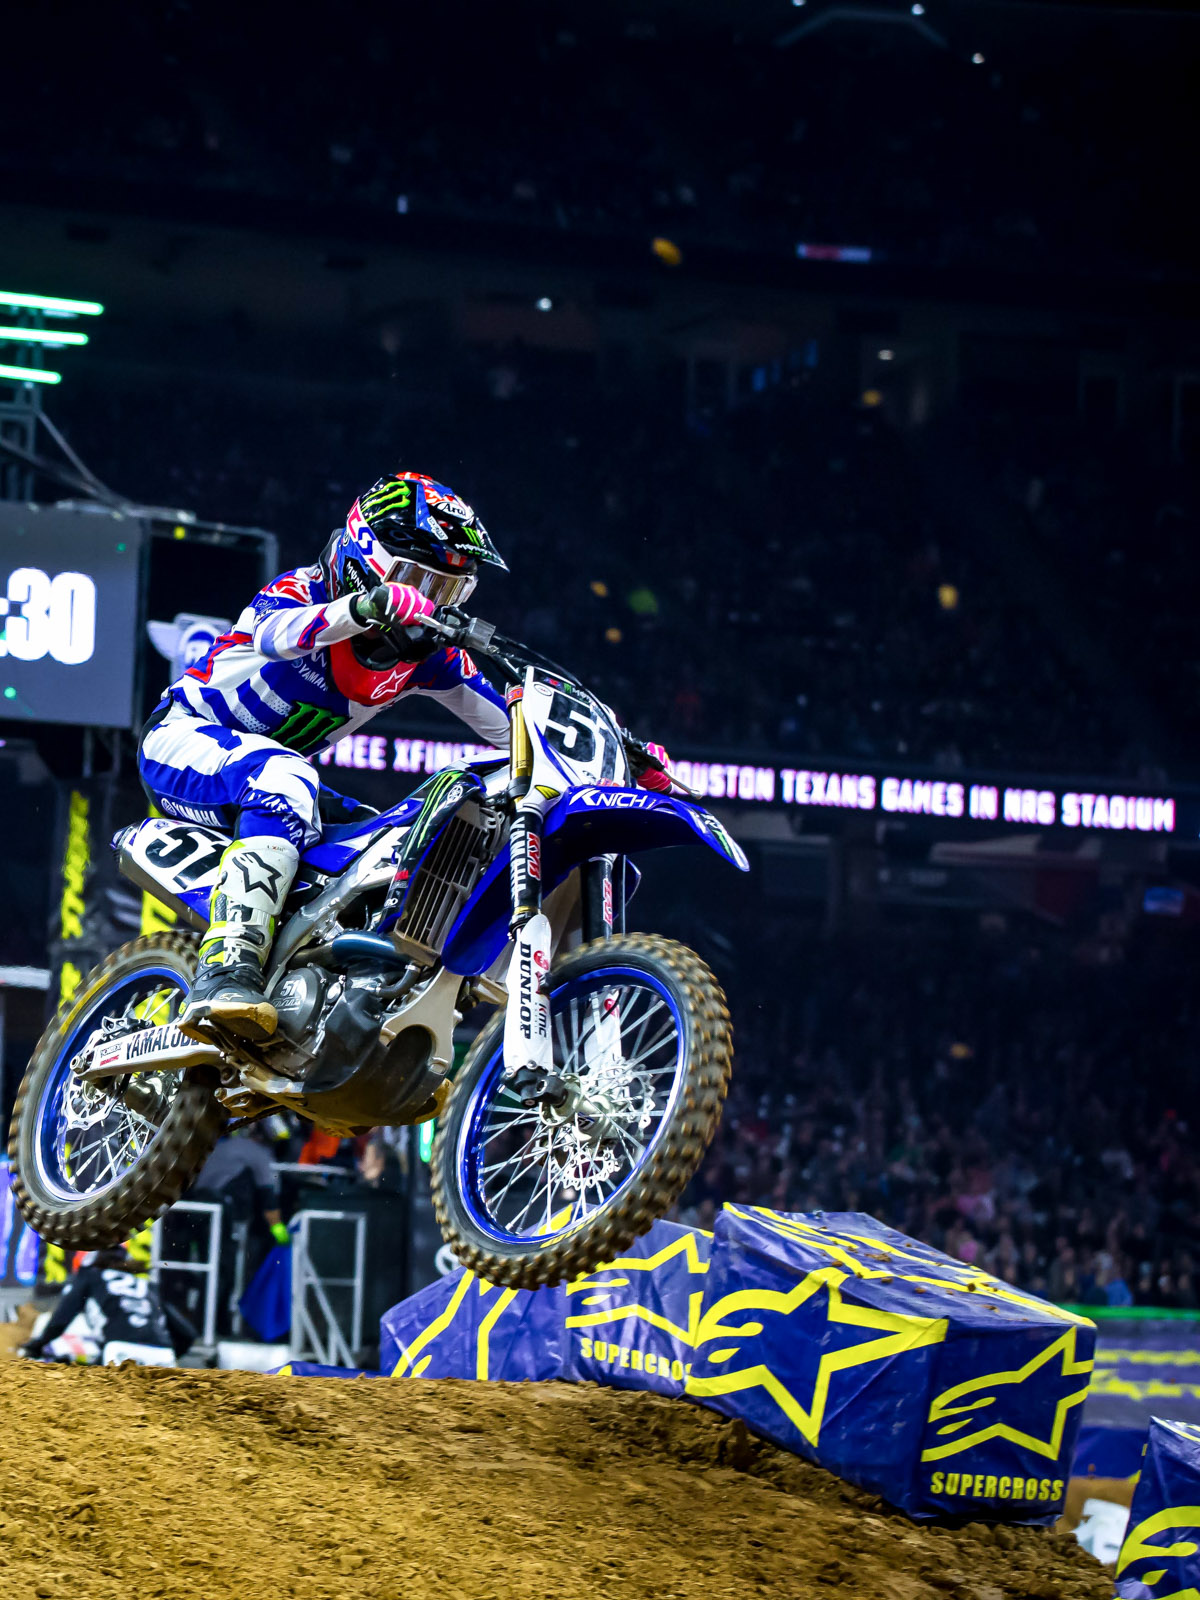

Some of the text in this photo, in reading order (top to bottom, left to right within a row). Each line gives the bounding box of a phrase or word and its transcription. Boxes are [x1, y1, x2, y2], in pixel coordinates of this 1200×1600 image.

[544, 691, 624, 785] 51
[172, 802, 222, 827] YAMAHA
[667, 760, 1176, 832] OUSTON TEXANS GAMES IN NRG STADIUM
[526, 832, 540, 881] KYB
[520, 941, 531, 1040] DUNLOP
[580, 1337, 692, 1382] SUPERCRO
[930, 1470, 1065, 1502] SUPERCROSS
